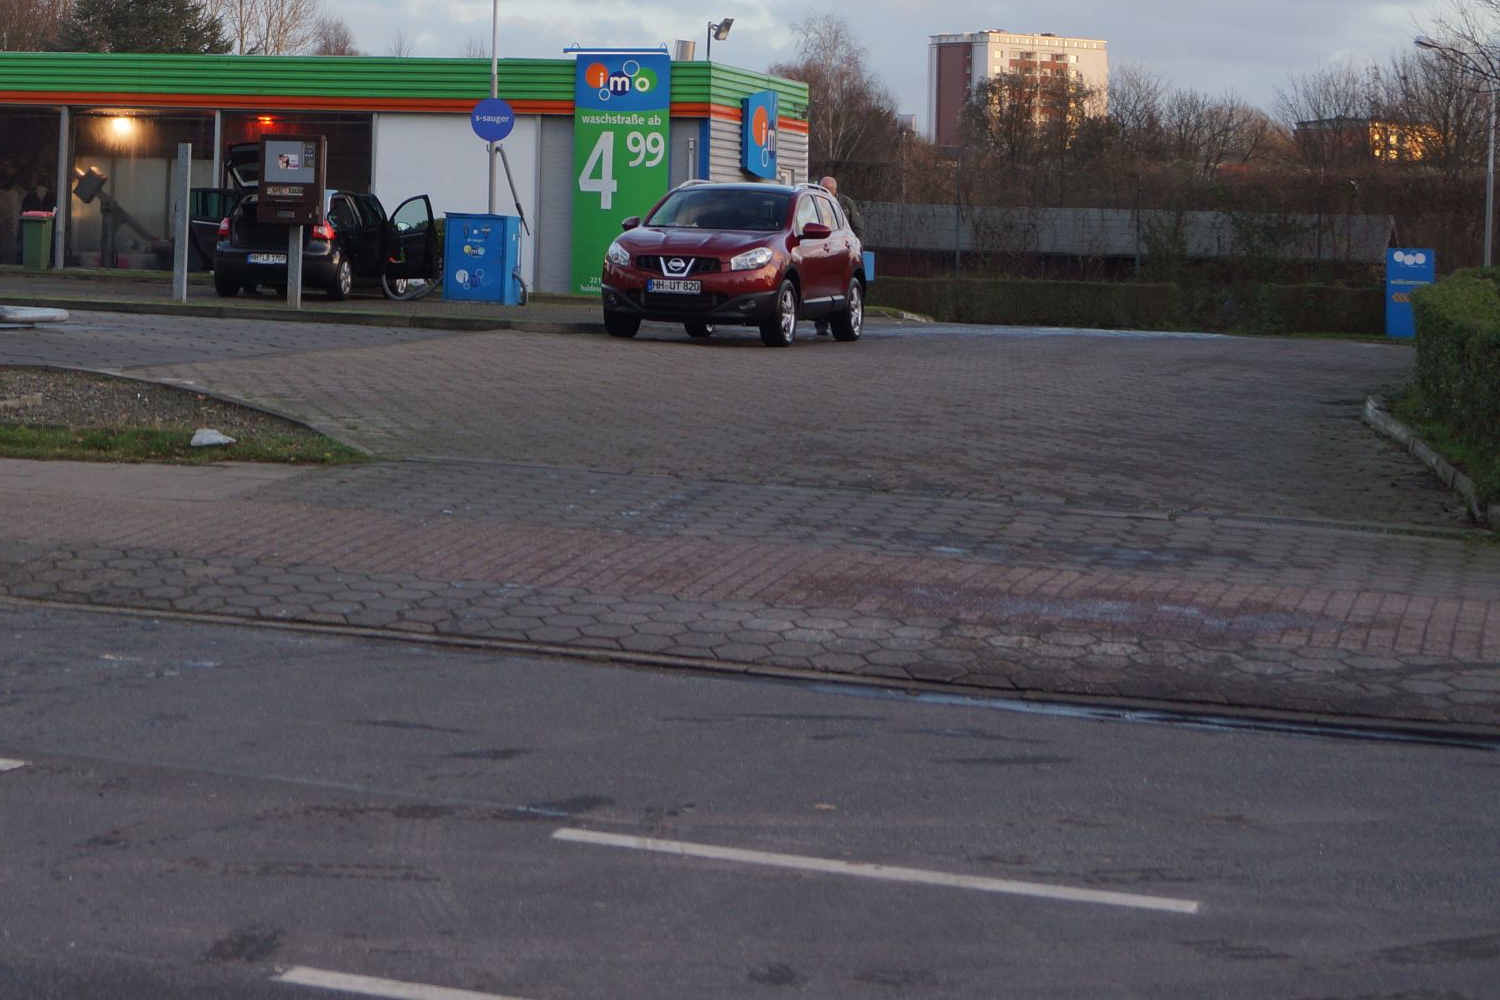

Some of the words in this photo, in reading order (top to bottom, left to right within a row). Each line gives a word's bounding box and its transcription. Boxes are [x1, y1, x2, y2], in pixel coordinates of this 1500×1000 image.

[599, 72, 650, 92] imo
[475, 115, 510, 125] s-sauger
[582, 113, 645, 126] waschstraße
[647, 115, 662, 126] ab
[579, 131, 618, 210] 4
[626, 131, 665, 168] 99
[653, 281, 664, 290] HH
[669, 281, 681, 291] UT
[683, 282, 700, 292] 820
